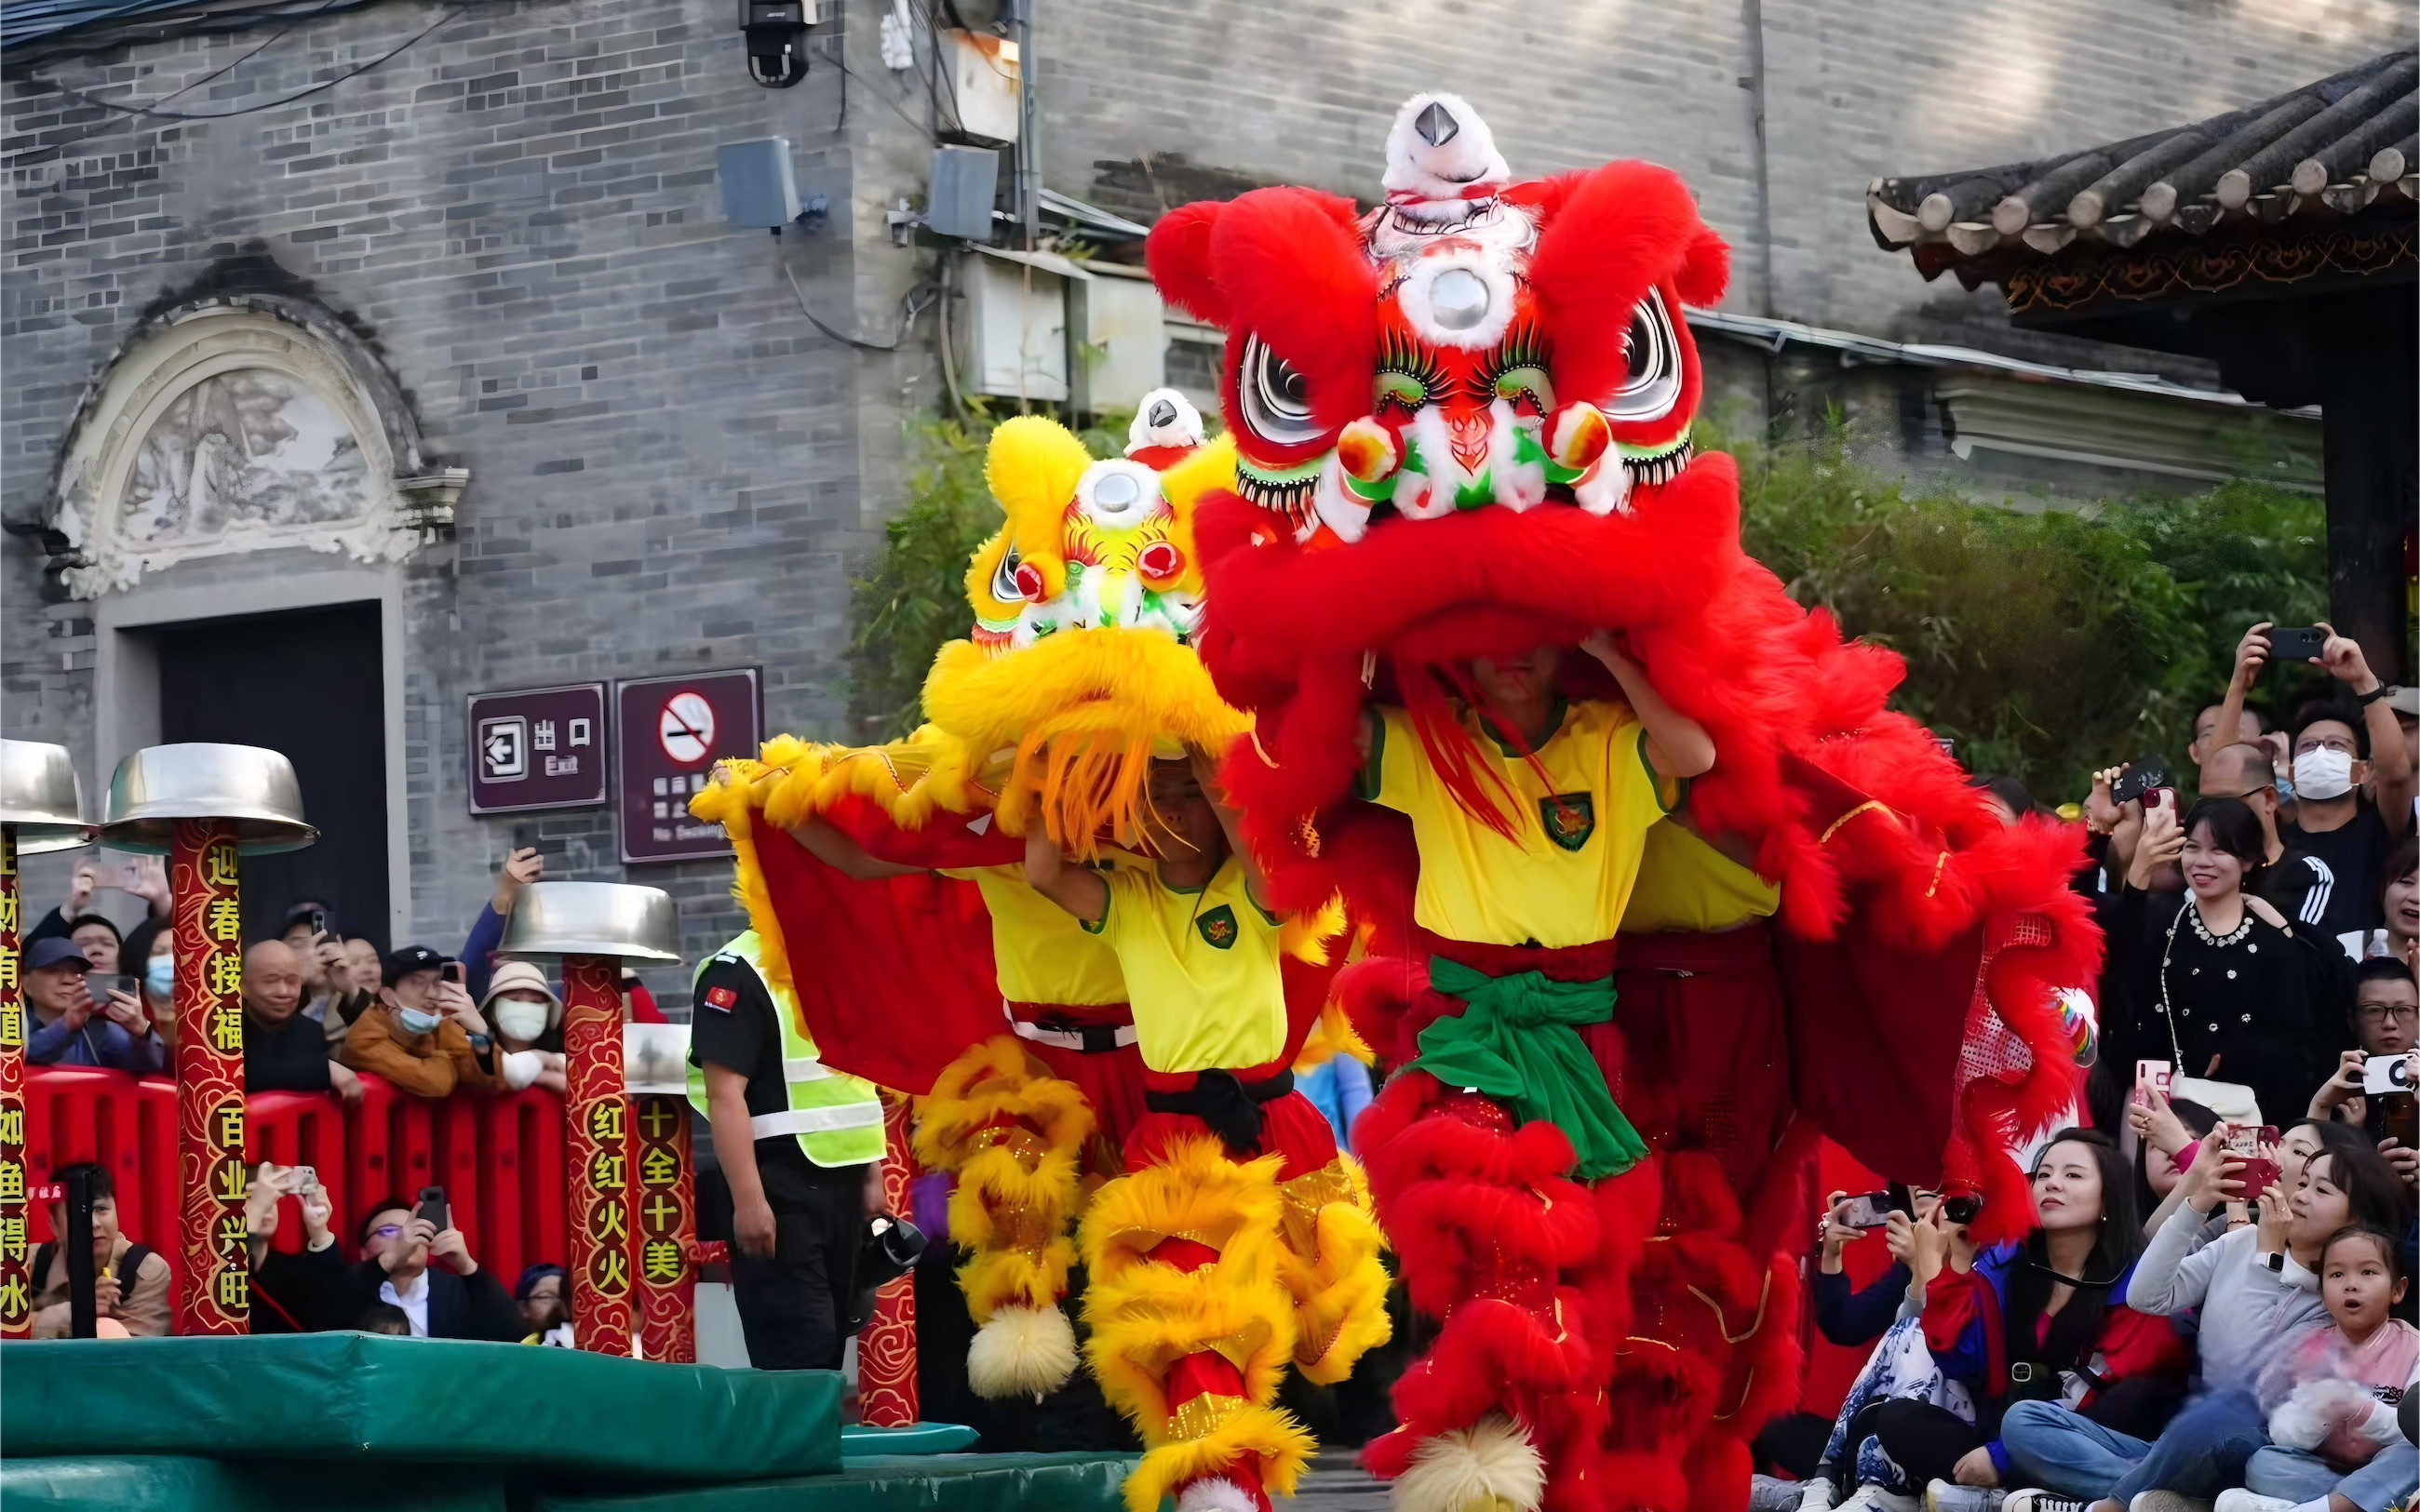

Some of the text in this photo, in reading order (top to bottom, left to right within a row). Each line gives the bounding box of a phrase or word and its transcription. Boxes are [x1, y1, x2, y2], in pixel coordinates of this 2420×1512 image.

[534, 717, 591, 751] 出口
[207, 845, 249, 1309] 迎春接福 百业兴旺
[0, 1104, 28, 1319] 如鱼得水
[593, 1102, 629, 1290] 红红火火
[639, 1101, 679, 1279] 十全十美
